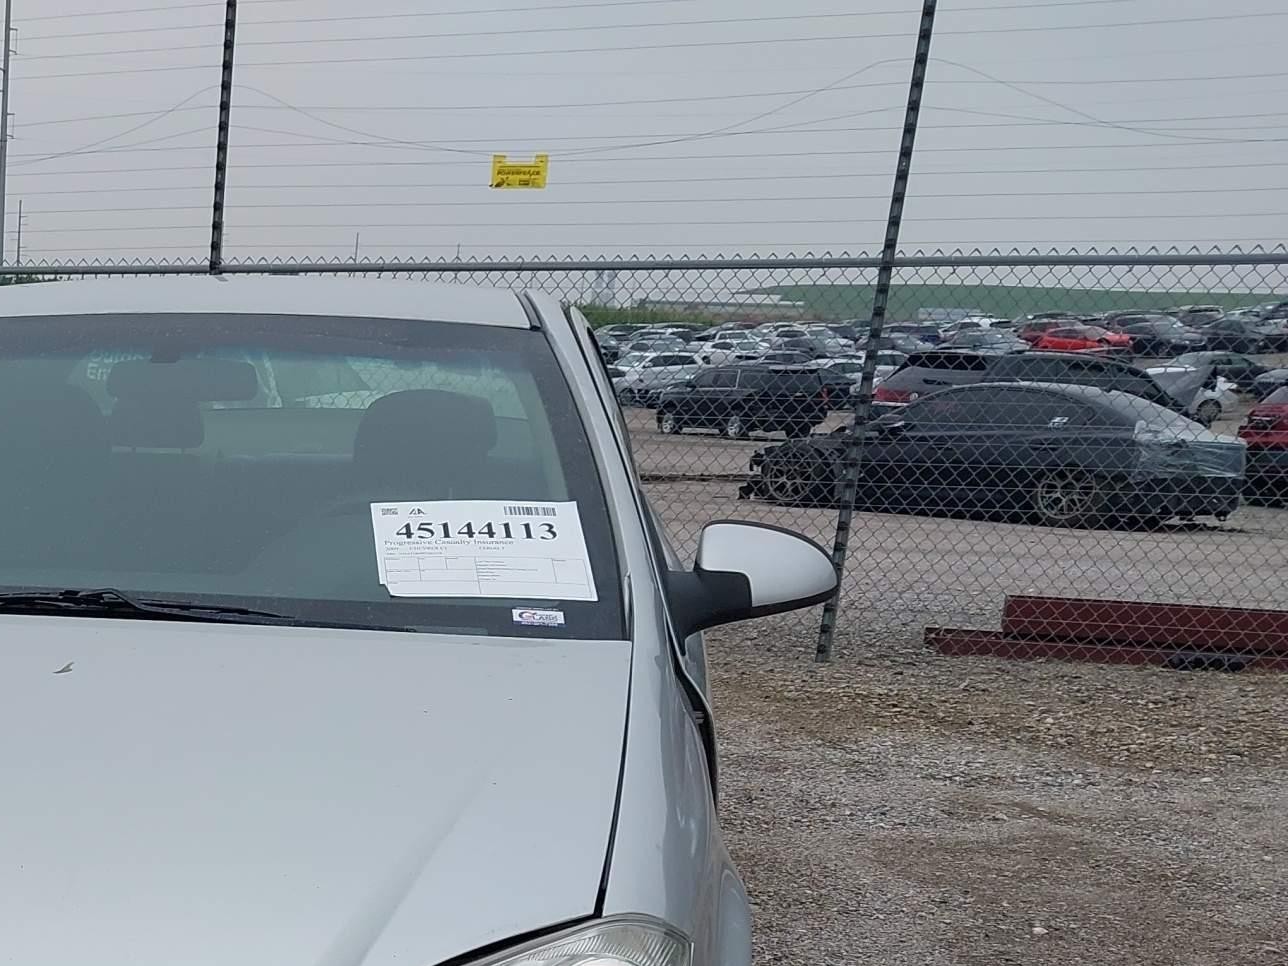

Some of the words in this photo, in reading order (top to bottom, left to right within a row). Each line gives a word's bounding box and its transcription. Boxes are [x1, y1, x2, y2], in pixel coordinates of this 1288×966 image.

[396, 522, 558, 540] 45144113
[384, 539, 433, 547] Progressive
[434, 539, 471, 547] Casualty
